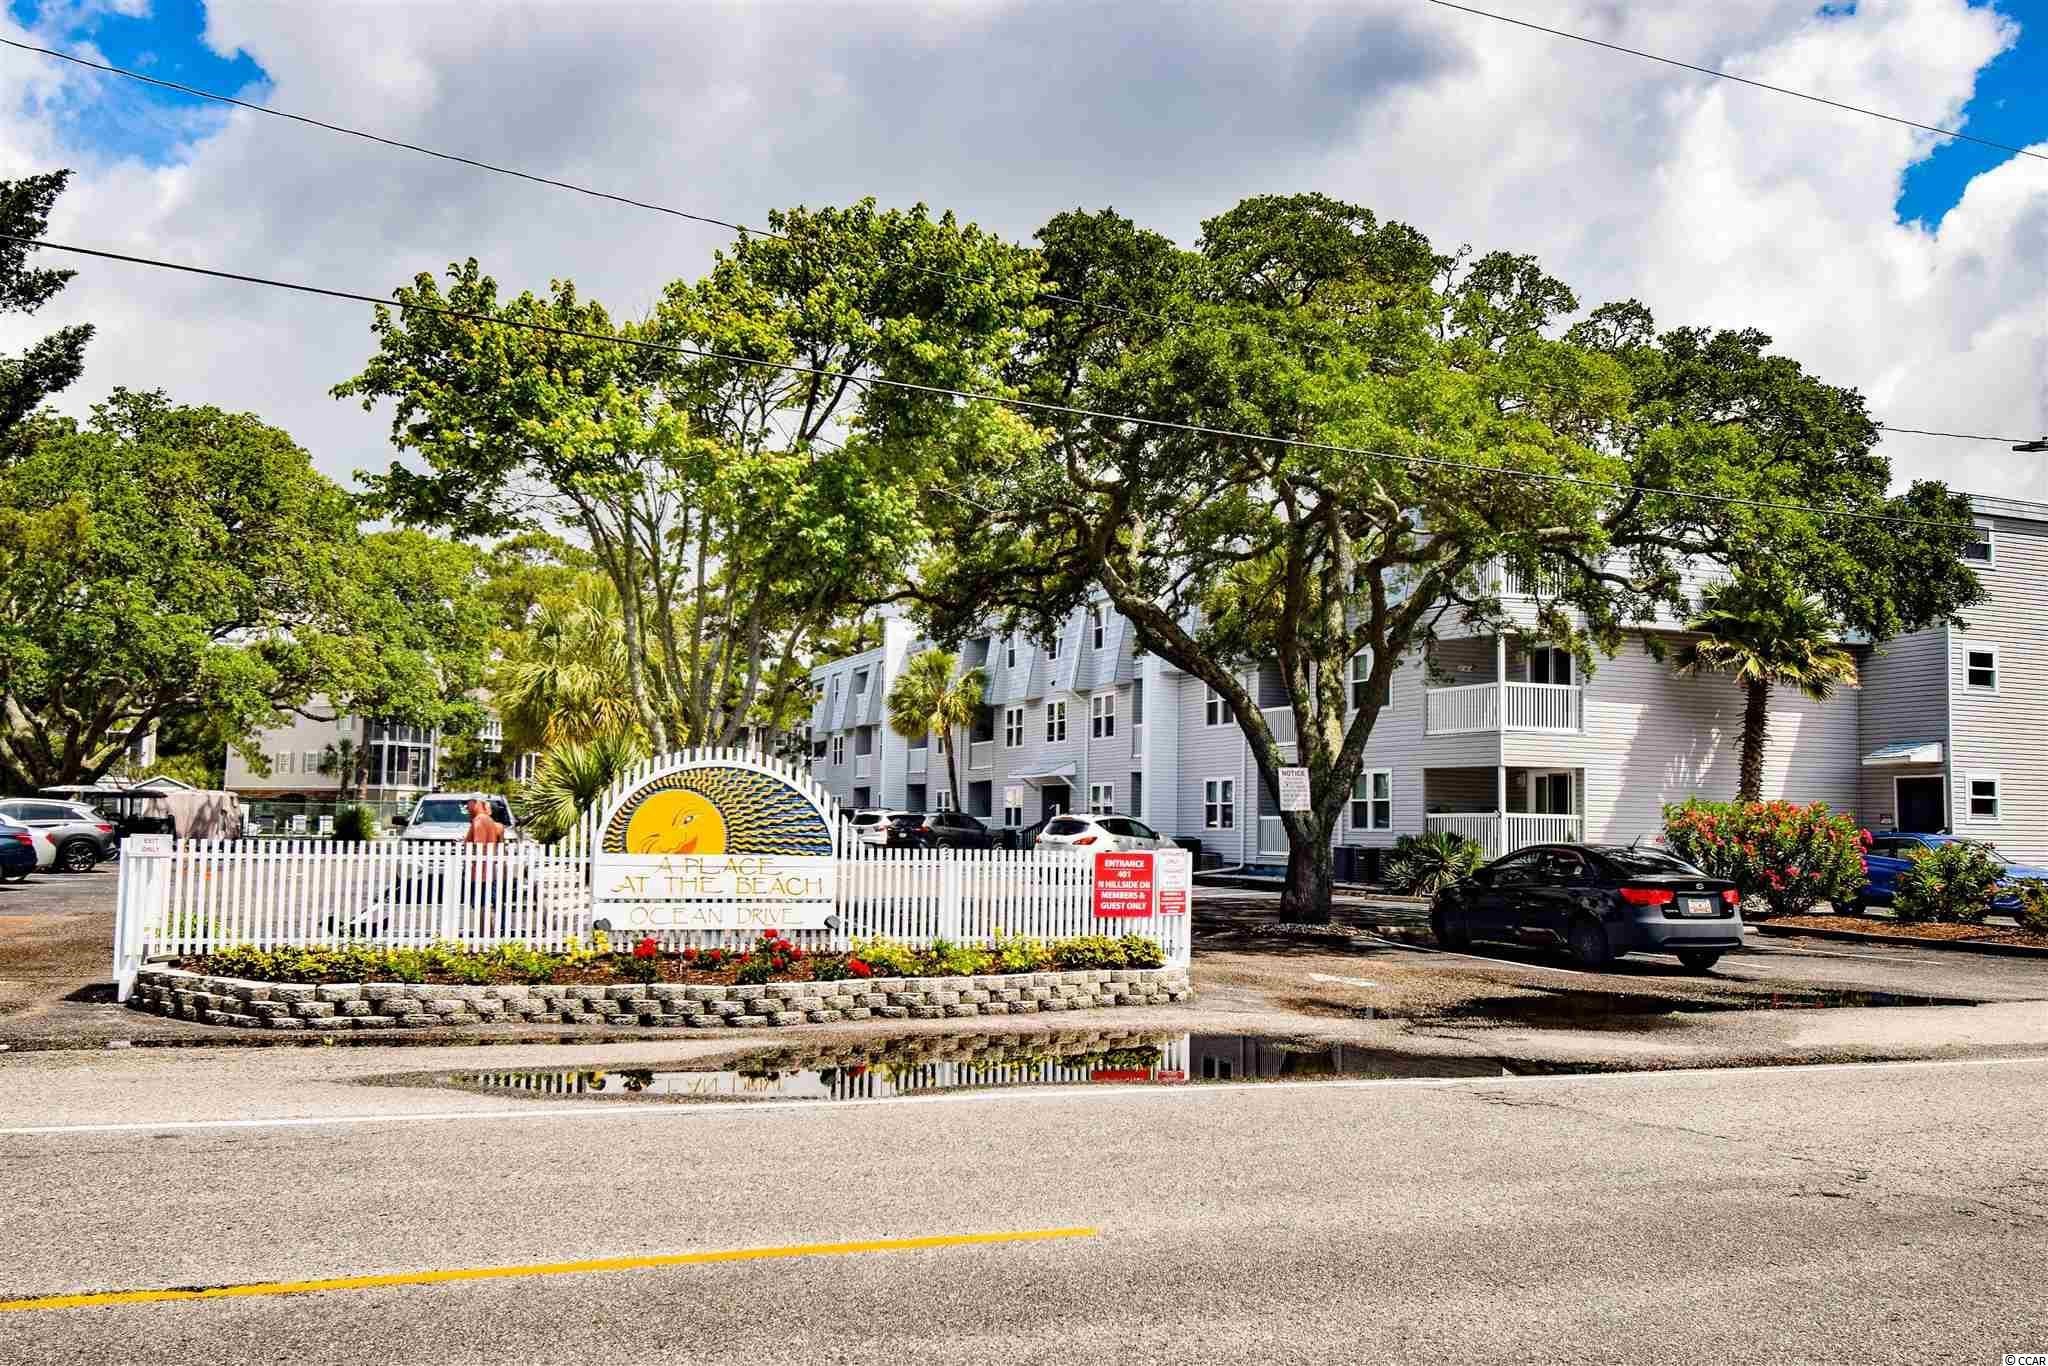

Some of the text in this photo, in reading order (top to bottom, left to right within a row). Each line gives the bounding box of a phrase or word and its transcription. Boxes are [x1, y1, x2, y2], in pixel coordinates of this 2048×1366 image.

[656, 857, 783, 875] A PLACE
[1104, 859, 1144, 868] ENTRANCE
[610, 876, 823, 895] AT THE BEACH
[1101, 891, 1137, 899] MEMBERS
[1101, 902, 1147, 910] GUEST ONLY
[630, 907, 804, 925] OCEAN DRIVE
